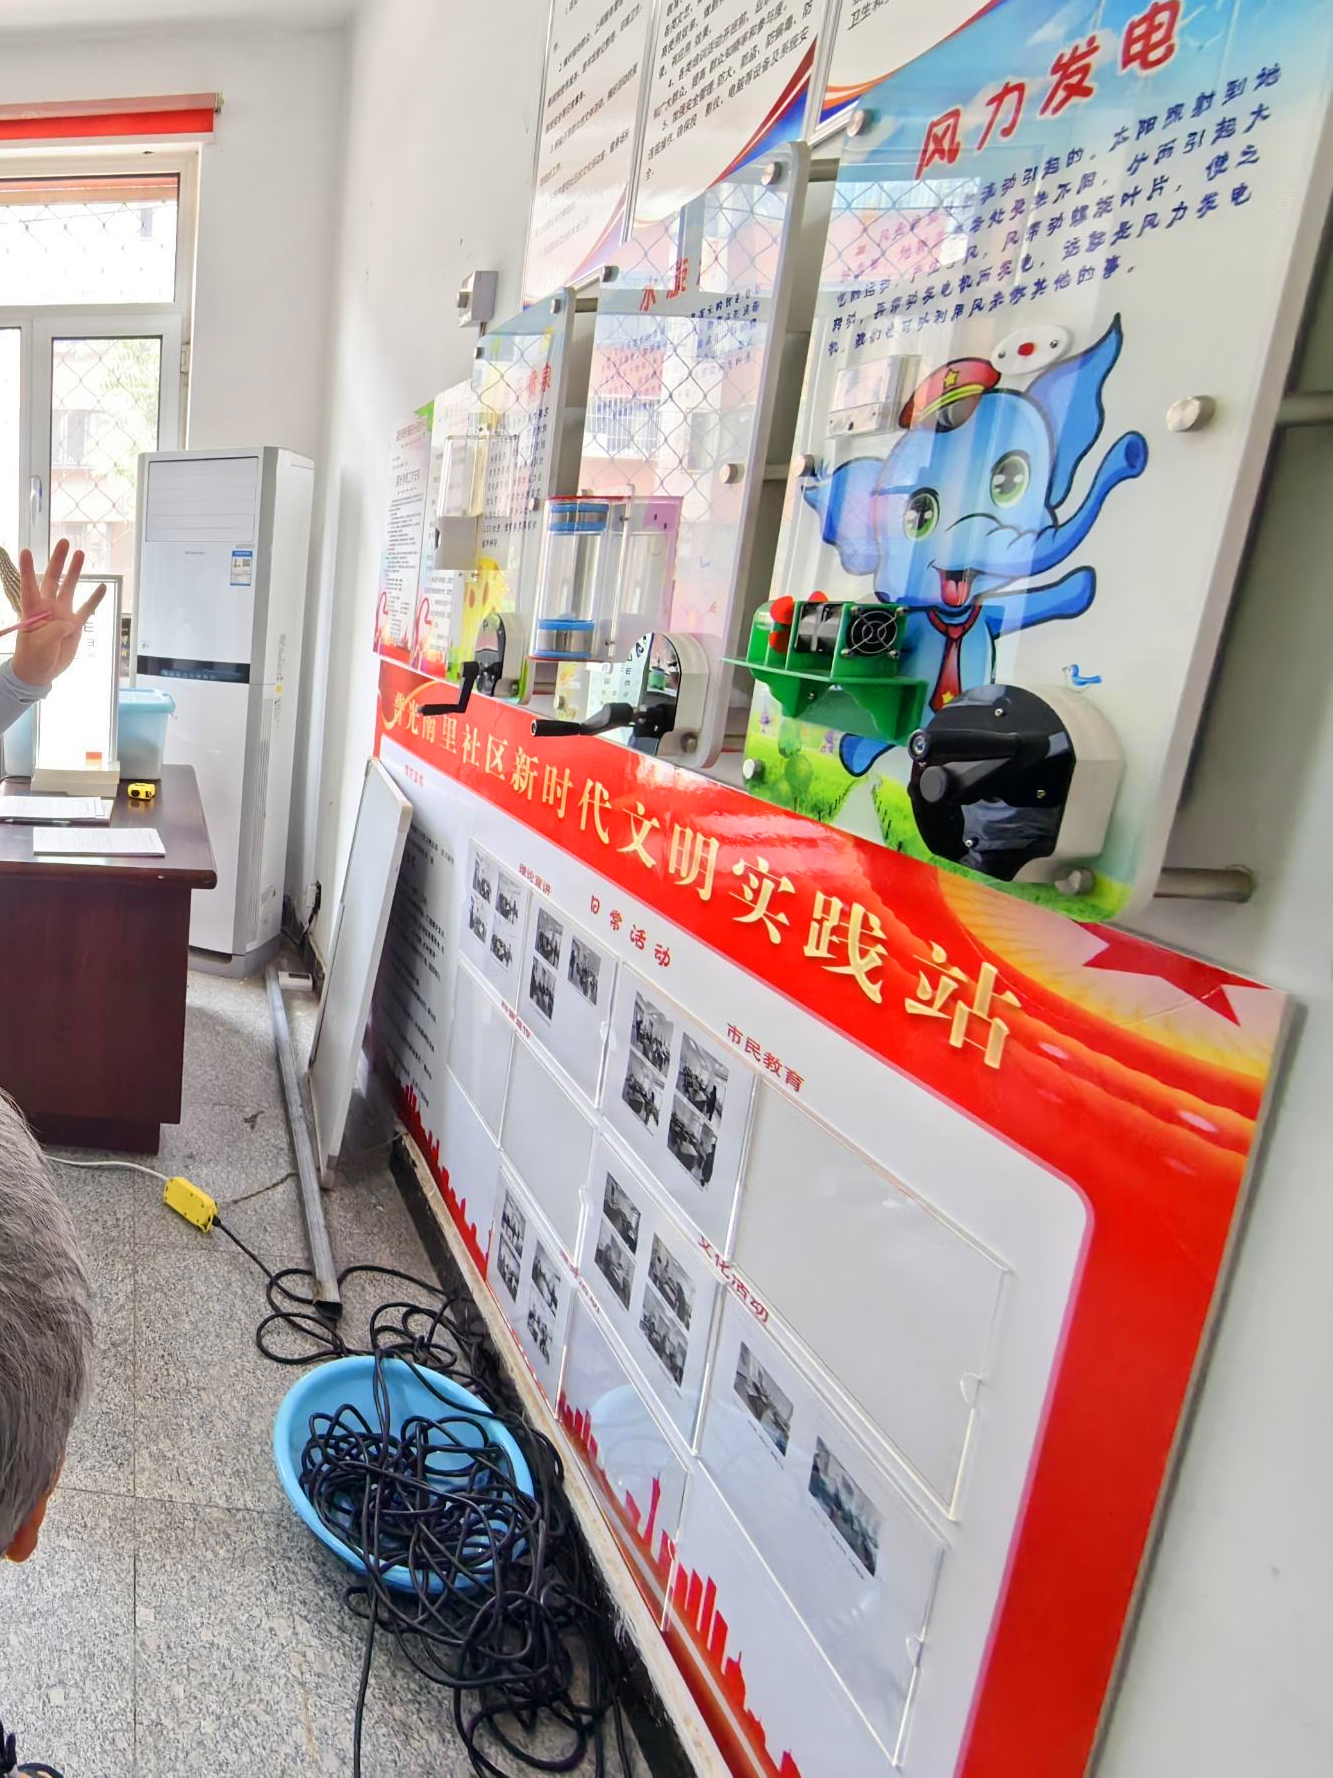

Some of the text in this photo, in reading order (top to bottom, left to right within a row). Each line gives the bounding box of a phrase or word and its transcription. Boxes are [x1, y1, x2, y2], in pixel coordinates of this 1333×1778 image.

[915, 0, 1180, 180] 风力发电
[590, 895, 671, 967] 日常活动
[727, 1022, 805, 1092] 市民教育
